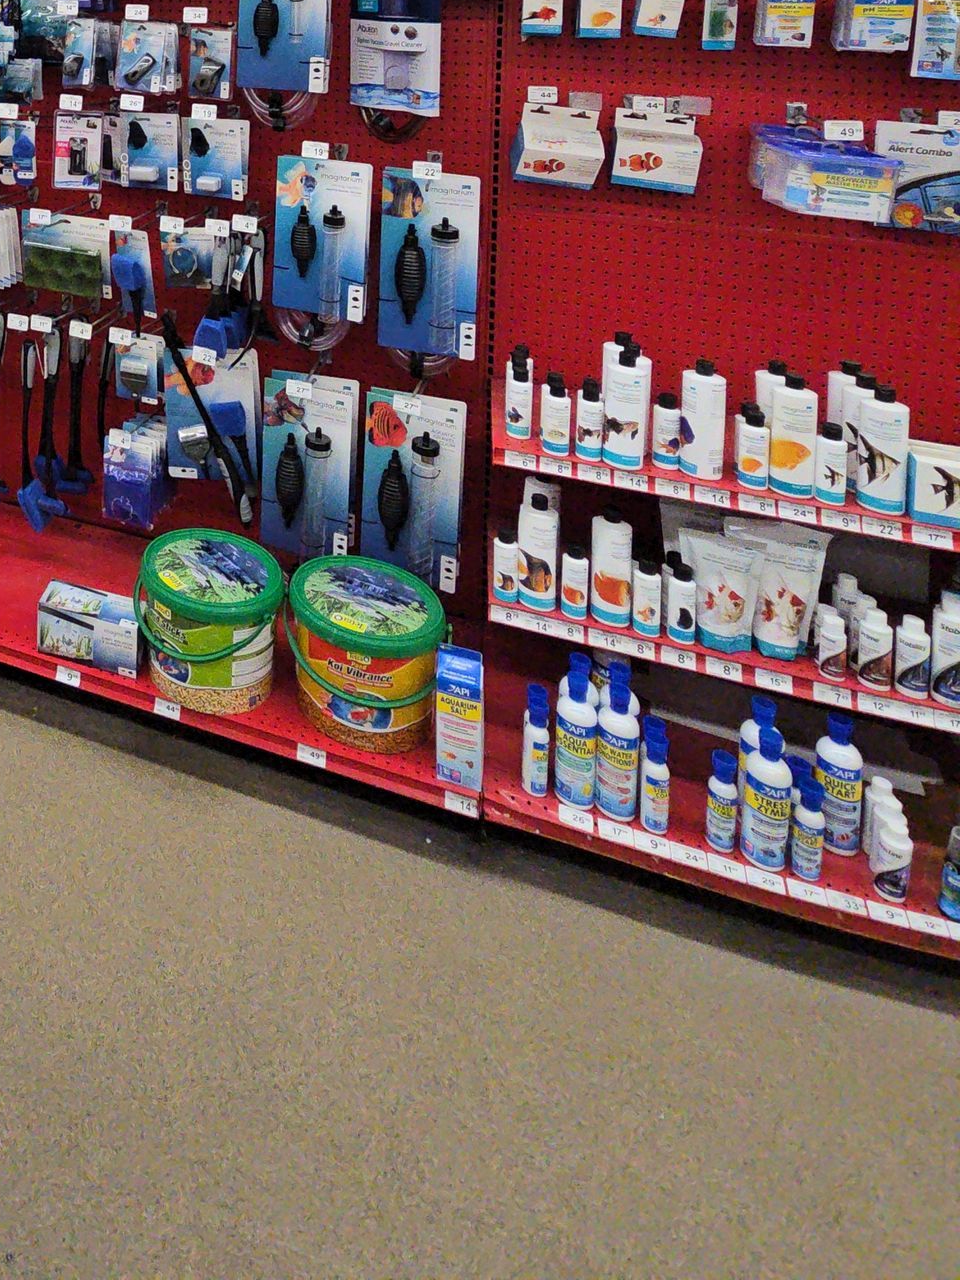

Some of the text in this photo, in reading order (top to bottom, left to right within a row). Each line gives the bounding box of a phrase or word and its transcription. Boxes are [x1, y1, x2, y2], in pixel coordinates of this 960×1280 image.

[646, 102, 664, 110] 44
[840, 127, 862, 137] 49
[888, 144, 953, 157] Alert Combo
[120, 152, 129, 188] PRO
[424, 168, 442, 177] 22
[183, 159, 192, 194] PRO
[320, 172, 363, 185] imagitarium
[826, 174, 879, 185] FRESHWATER
[429, 186, 475, 197] imagitarium
[306, 398, 348, 413] imagitarium
[416, 415, 457, 431] imagitarium
[162, 620, 187, 641] Sticks
[536, 622, 553, 632] 14
[604, 637, 622, 648] 14
[327, 658, 393, 683] Koi Vibrance
[451, 685, 470, 697] API
[166, 704, 180, 713] 44
[440, 696, 478, 712] AQUARIUM
[449, 706, 468, 716] SALT
[566, 726, 586, 737] API
[563, 733, 588, 748] AQUA
[607, 738, 627, 749] API
[609, 748, 633, 759] WATER
[832, 770, 856, 780] API
[824, 775, 857, 791] QUICK
[765, 787, 787, 799] API
[825, 785, 856, 799] START
[753, 792, 789, 809] STRESS
[757, 804, 787, 818] ZYME
